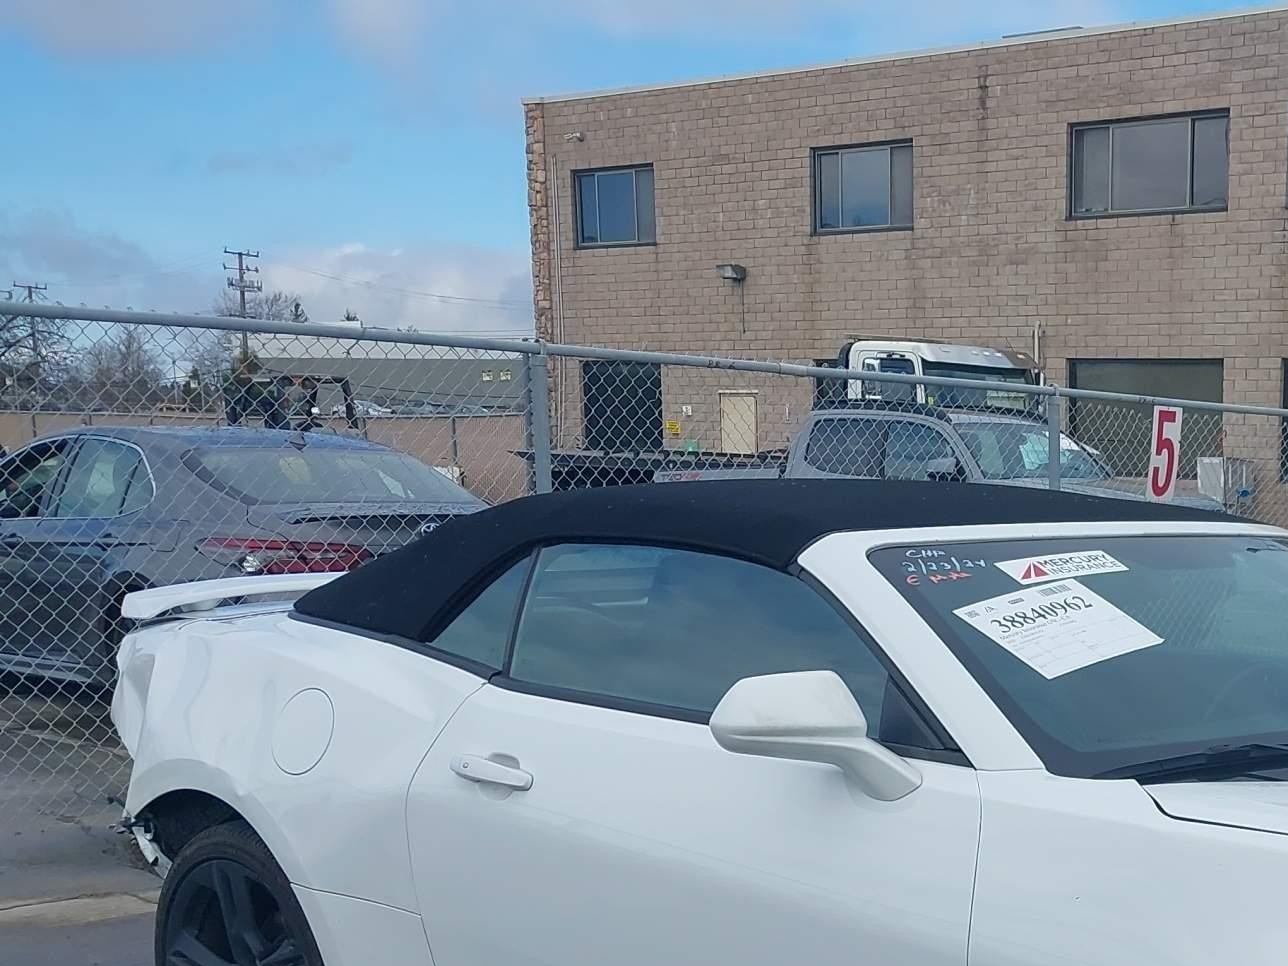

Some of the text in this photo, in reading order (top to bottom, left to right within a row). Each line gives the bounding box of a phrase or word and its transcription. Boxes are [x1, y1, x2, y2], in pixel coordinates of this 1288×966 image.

[1152, 409, 1177, 497] 5
[902, 556, 986, 575] 2/23/24
[1036, 554, 1110, 569] MERCURY
[1047, 561, 1122, 576] INSURANCE
[990, 595, 1094, 633] 38840962
